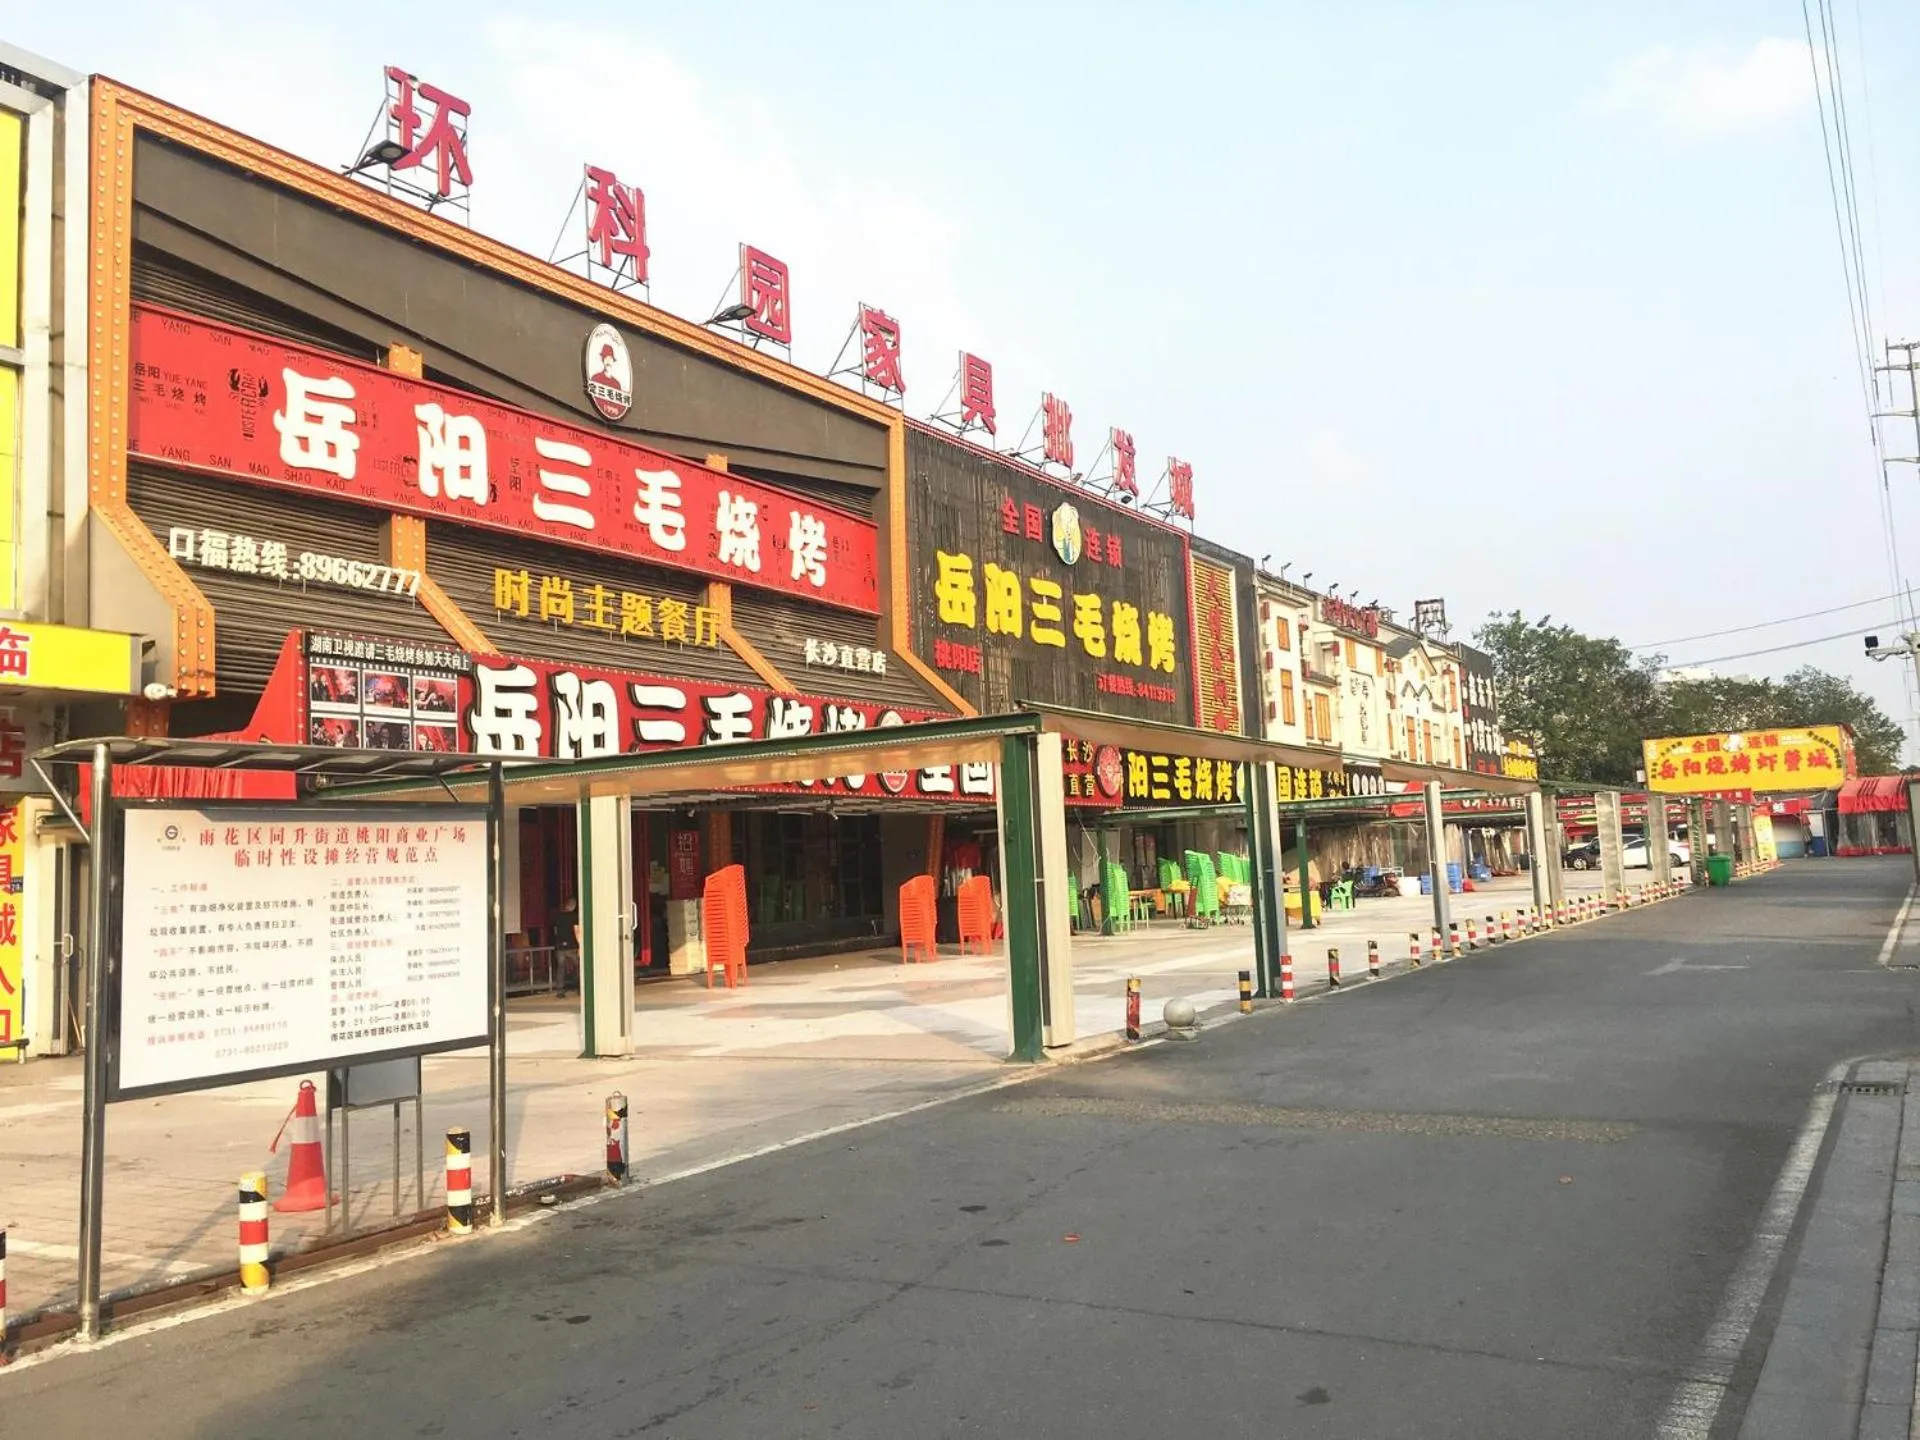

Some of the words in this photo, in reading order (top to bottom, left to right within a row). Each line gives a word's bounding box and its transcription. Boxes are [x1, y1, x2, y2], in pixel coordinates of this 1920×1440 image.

[160, 444, 191, 462] YANG
[209, 455, 232, 470] SAN
[272, 367, 828, 588] 岳阳三毛烧烤
[1001, 495, 1043, 543] 全国
[495, 568, 722, 648] 时尚主题餐厅
[934, 550, 1176, 673] 岳阳三毛烧烤
[200, 826, 466, 846] 雨花区同升街道桃阳商业广场
[234, 847, 438, 868] 临时性设摊经营规范点
